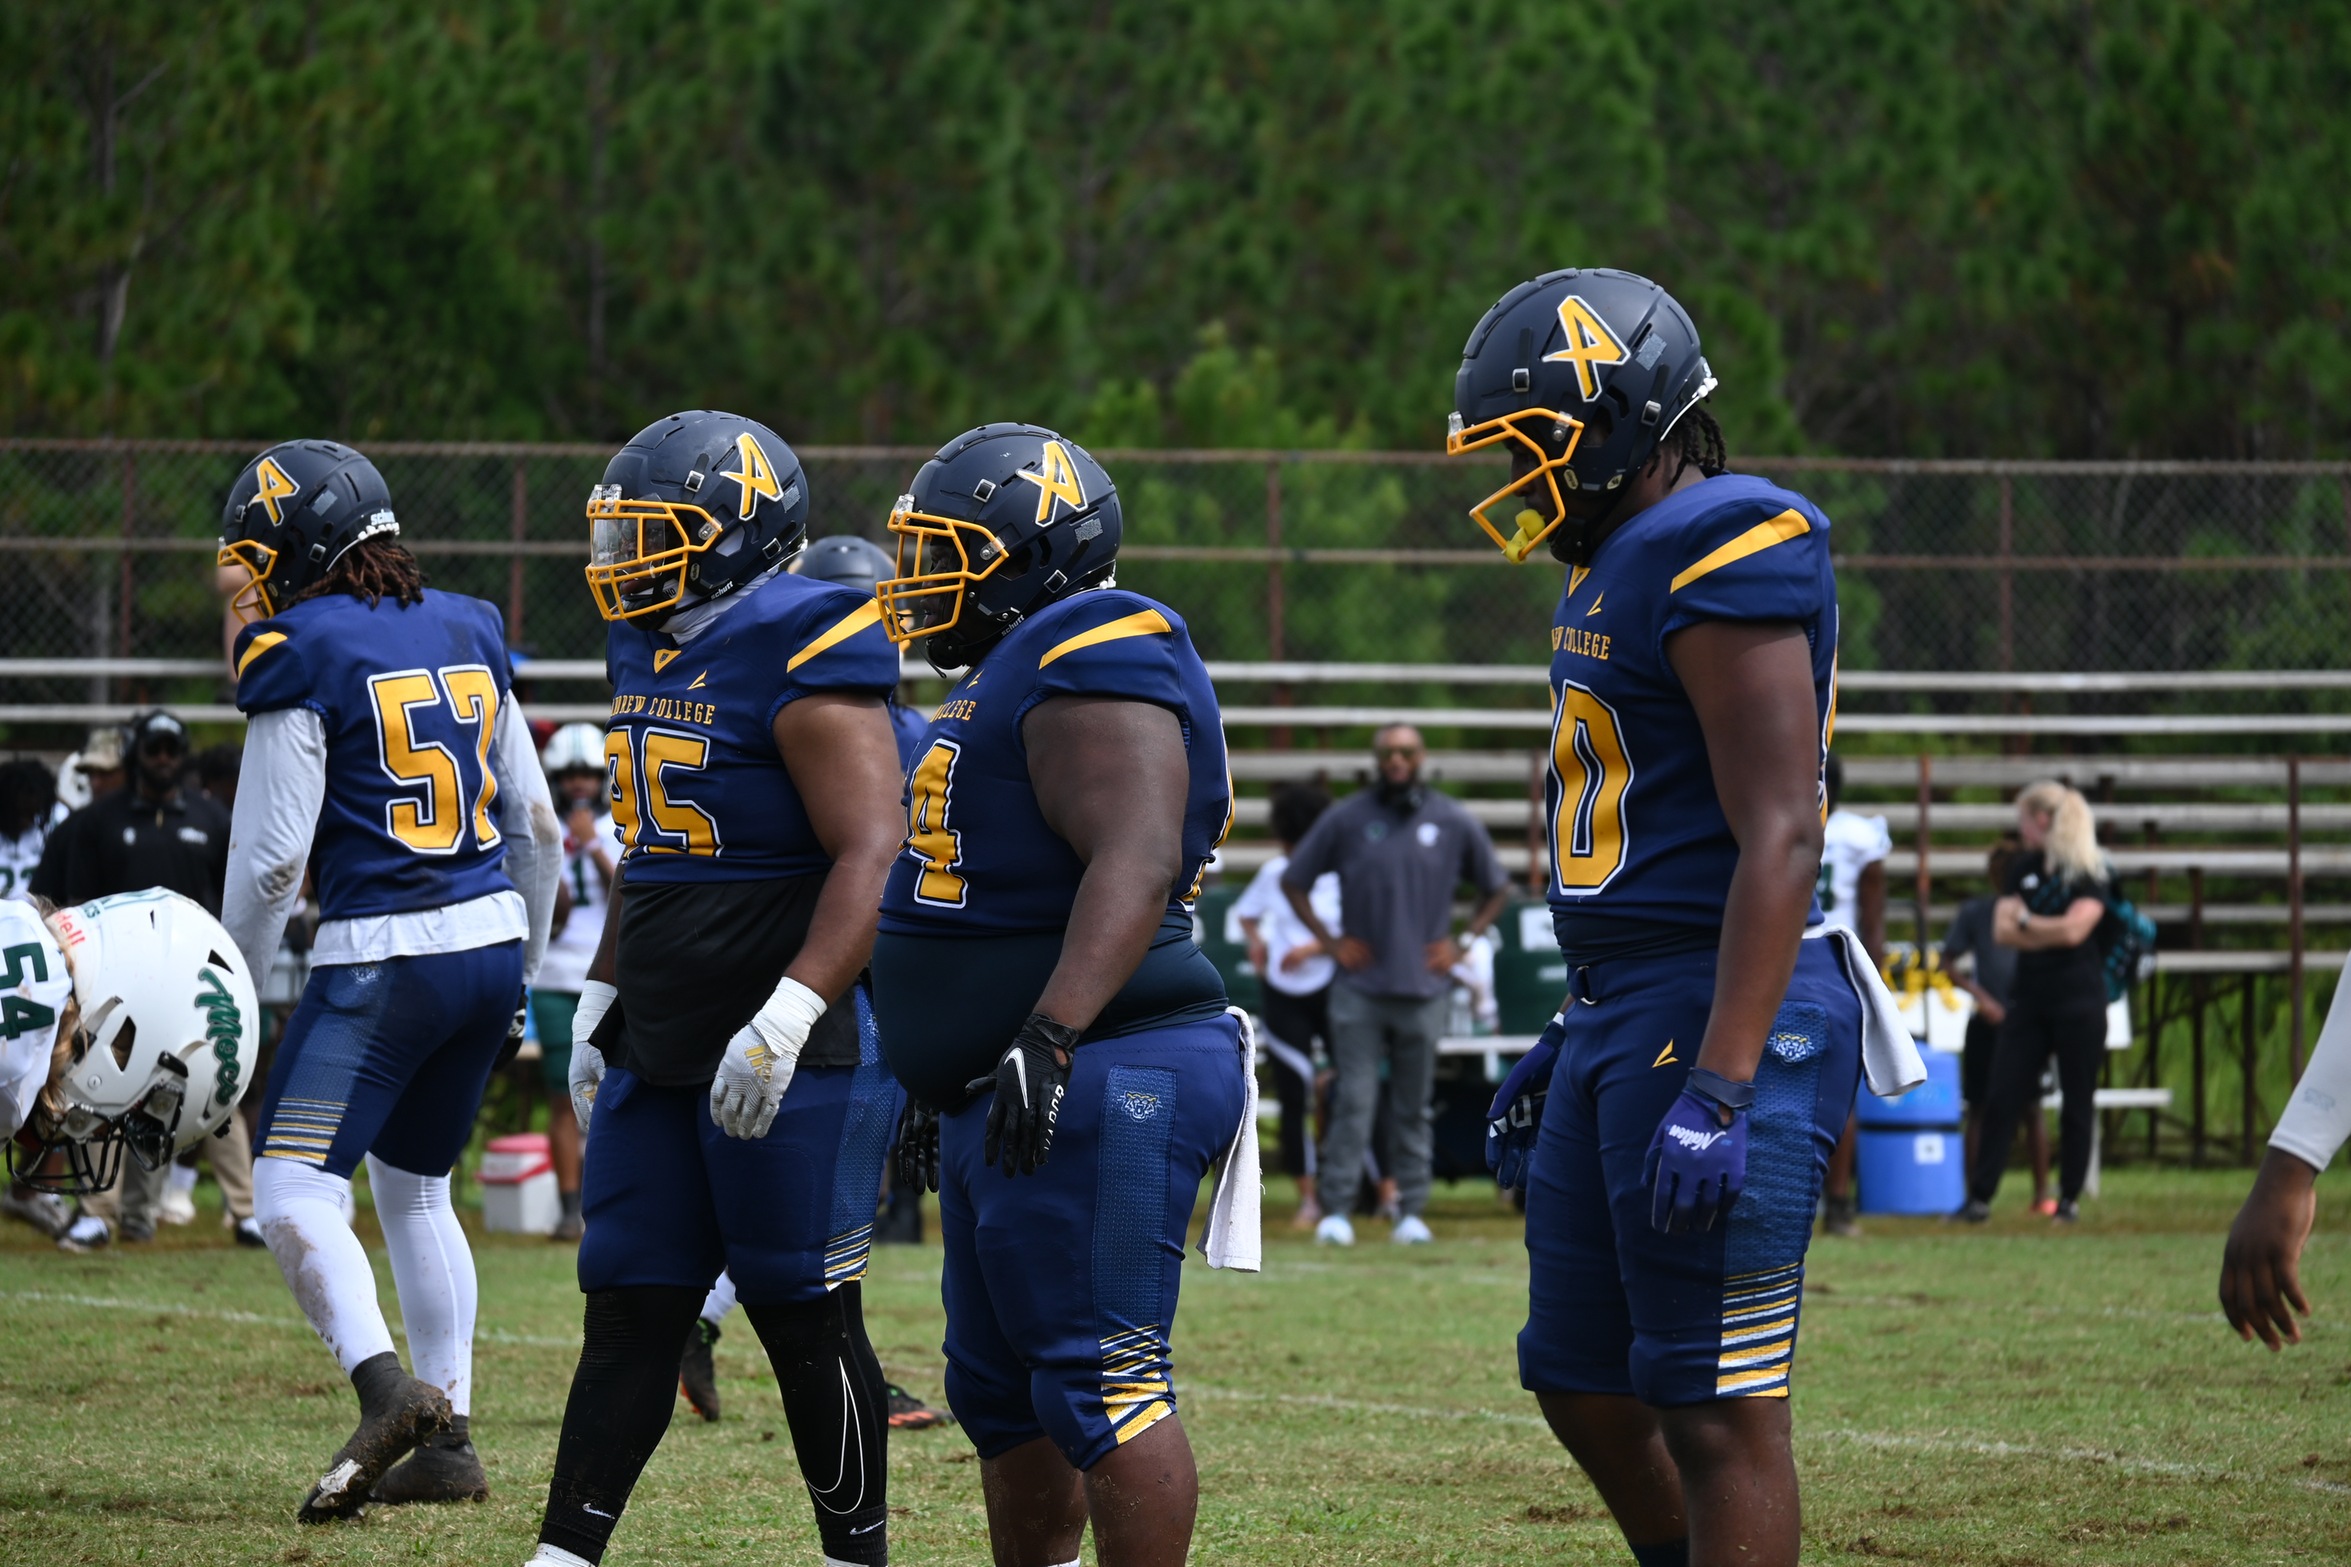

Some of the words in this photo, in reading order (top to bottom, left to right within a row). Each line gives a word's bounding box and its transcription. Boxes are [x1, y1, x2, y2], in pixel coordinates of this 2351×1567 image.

[366, 664, 501, 855] 57
[648, 697, 716, 725] COLLEGE
[604, 725, 723, 858] 95
[906, 738, 969, 909] 4
[1549, 679, 1635, 896] 0
[0, 942, 55, 1041] 54
[194, 967, 243, 1106] Mocs
